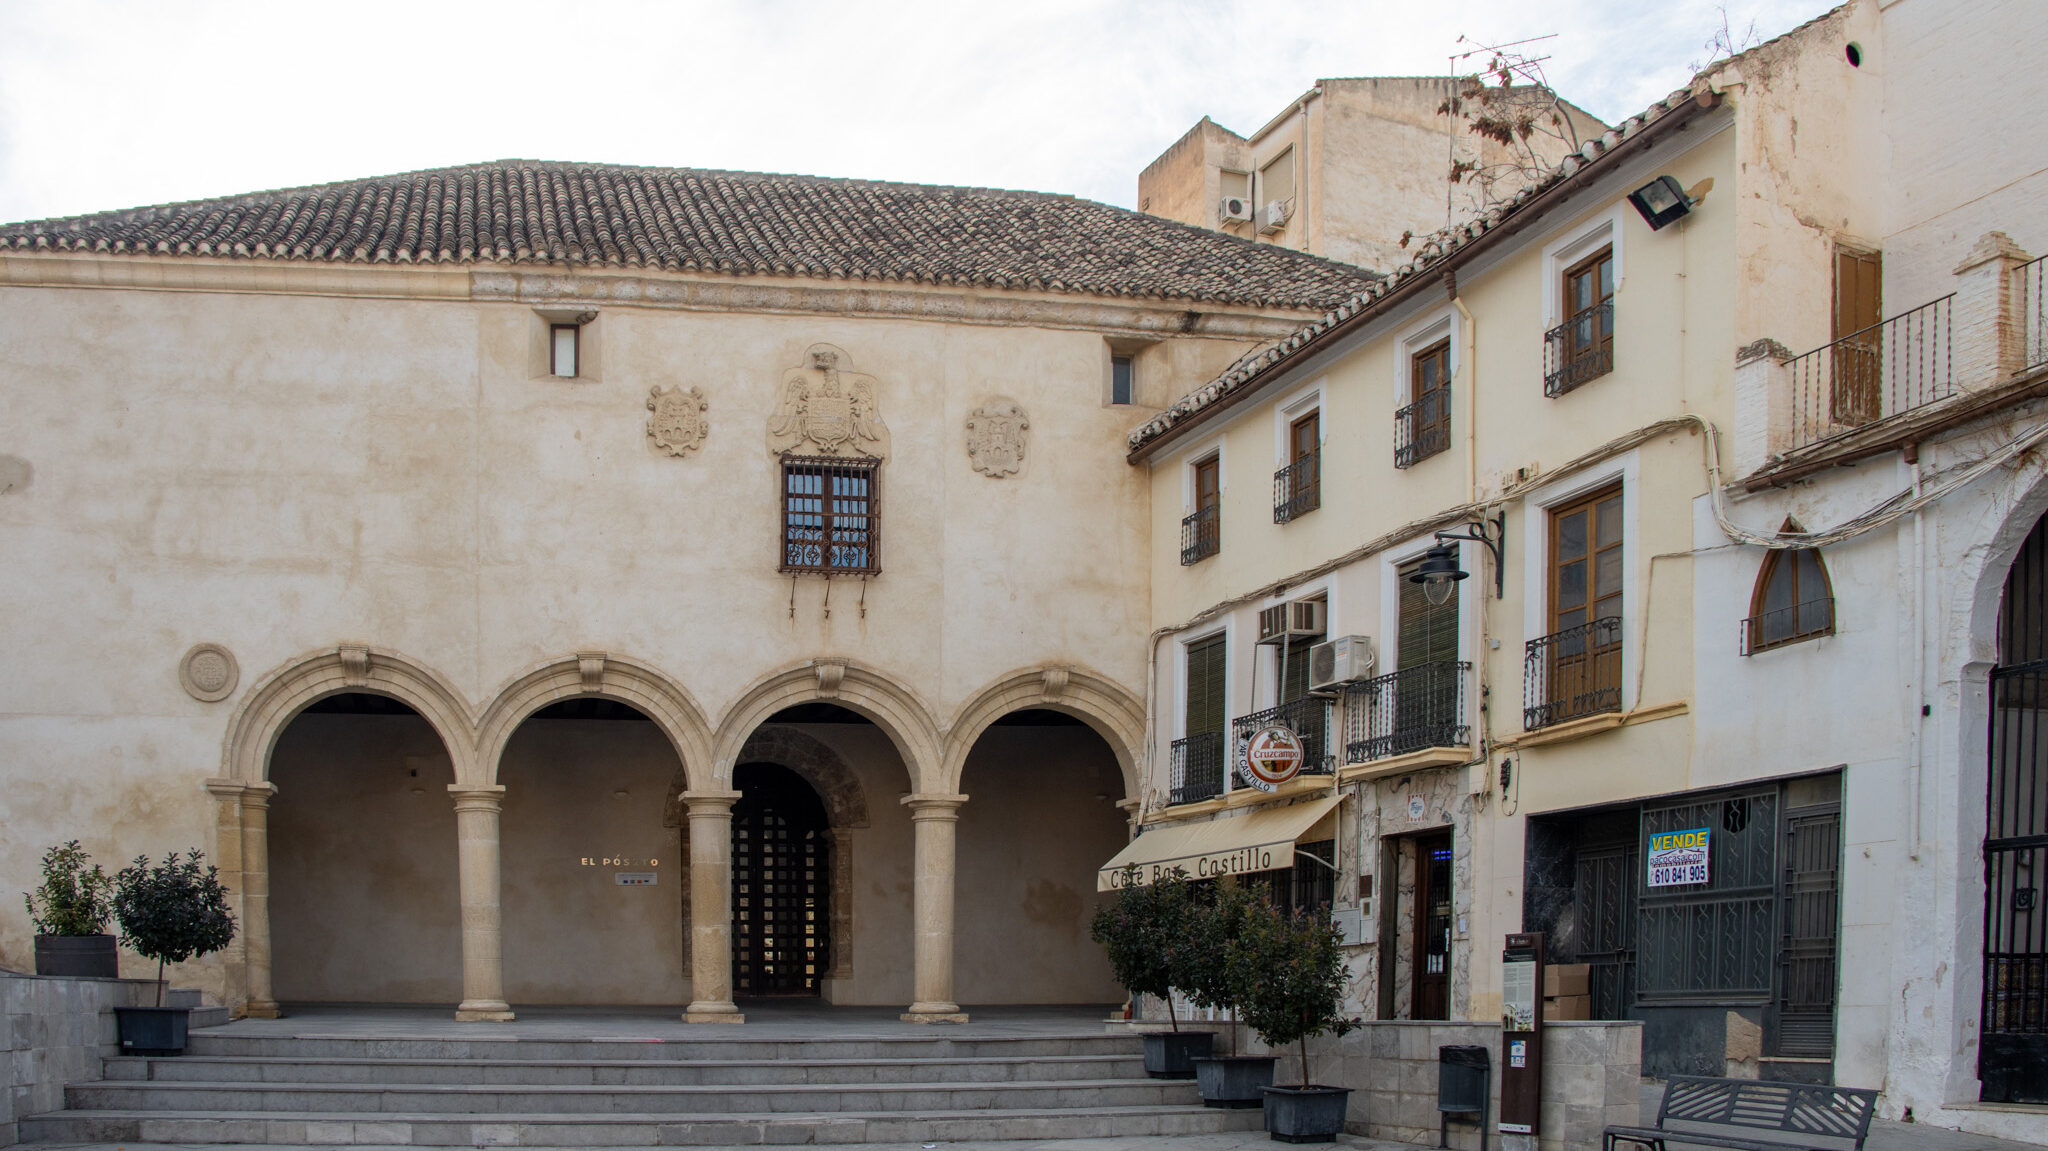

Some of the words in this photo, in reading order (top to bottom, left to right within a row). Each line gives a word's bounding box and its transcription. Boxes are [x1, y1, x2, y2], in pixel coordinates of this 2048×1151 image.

[1253, 750, 1299, 758] Cruzcampo
[1240, 760, 1270, 791] CASTILLO
[1652, 831, 1707, 851] VENDE
[581, 857, 596, 866] EL
[1198, 848, 1271, 877] Castillo
[1650, 853, 1705, 866] pacocasa.com
[1655, 868, 1670, 884] 610
[1672, 867, 1686, 882] 841
[1690, 865, 1706, 881] 905
